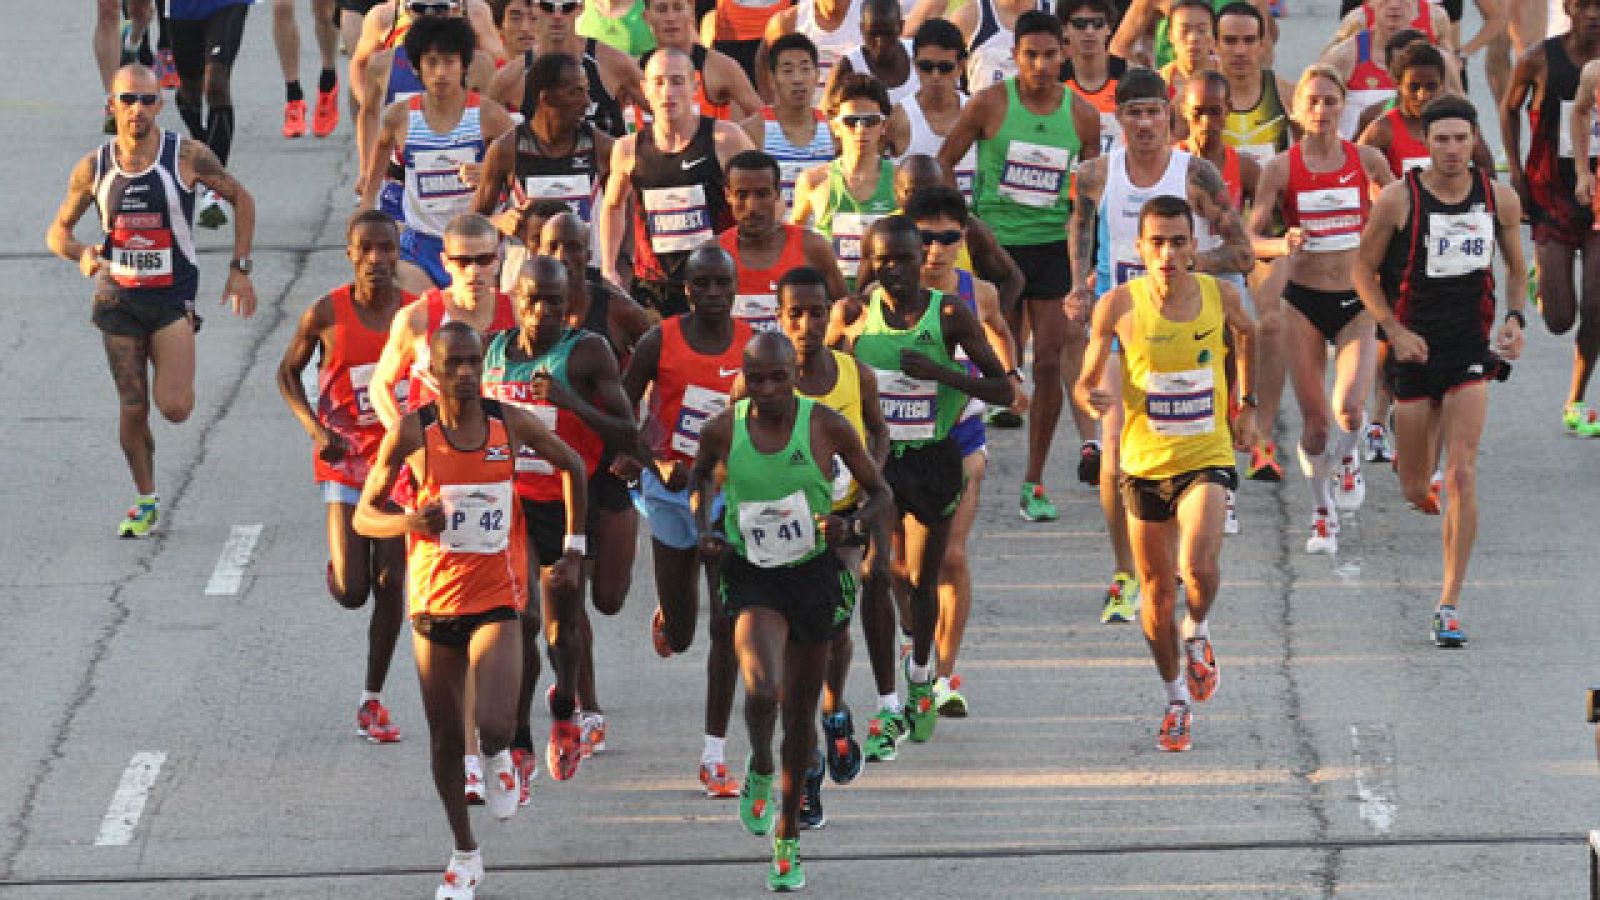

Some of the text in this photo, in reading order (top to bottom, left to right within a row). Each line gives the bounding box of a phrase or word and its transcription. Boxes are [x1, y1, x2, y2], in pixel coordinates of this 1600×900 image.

[1003, 164, 1060, 190] MACIAS
[1438, 237, 1484, 256] P 48
[482, 382, 533, 401] KEN
[452, 509, 503, 532] P 42
[751, 519, 803, 546] P 41
